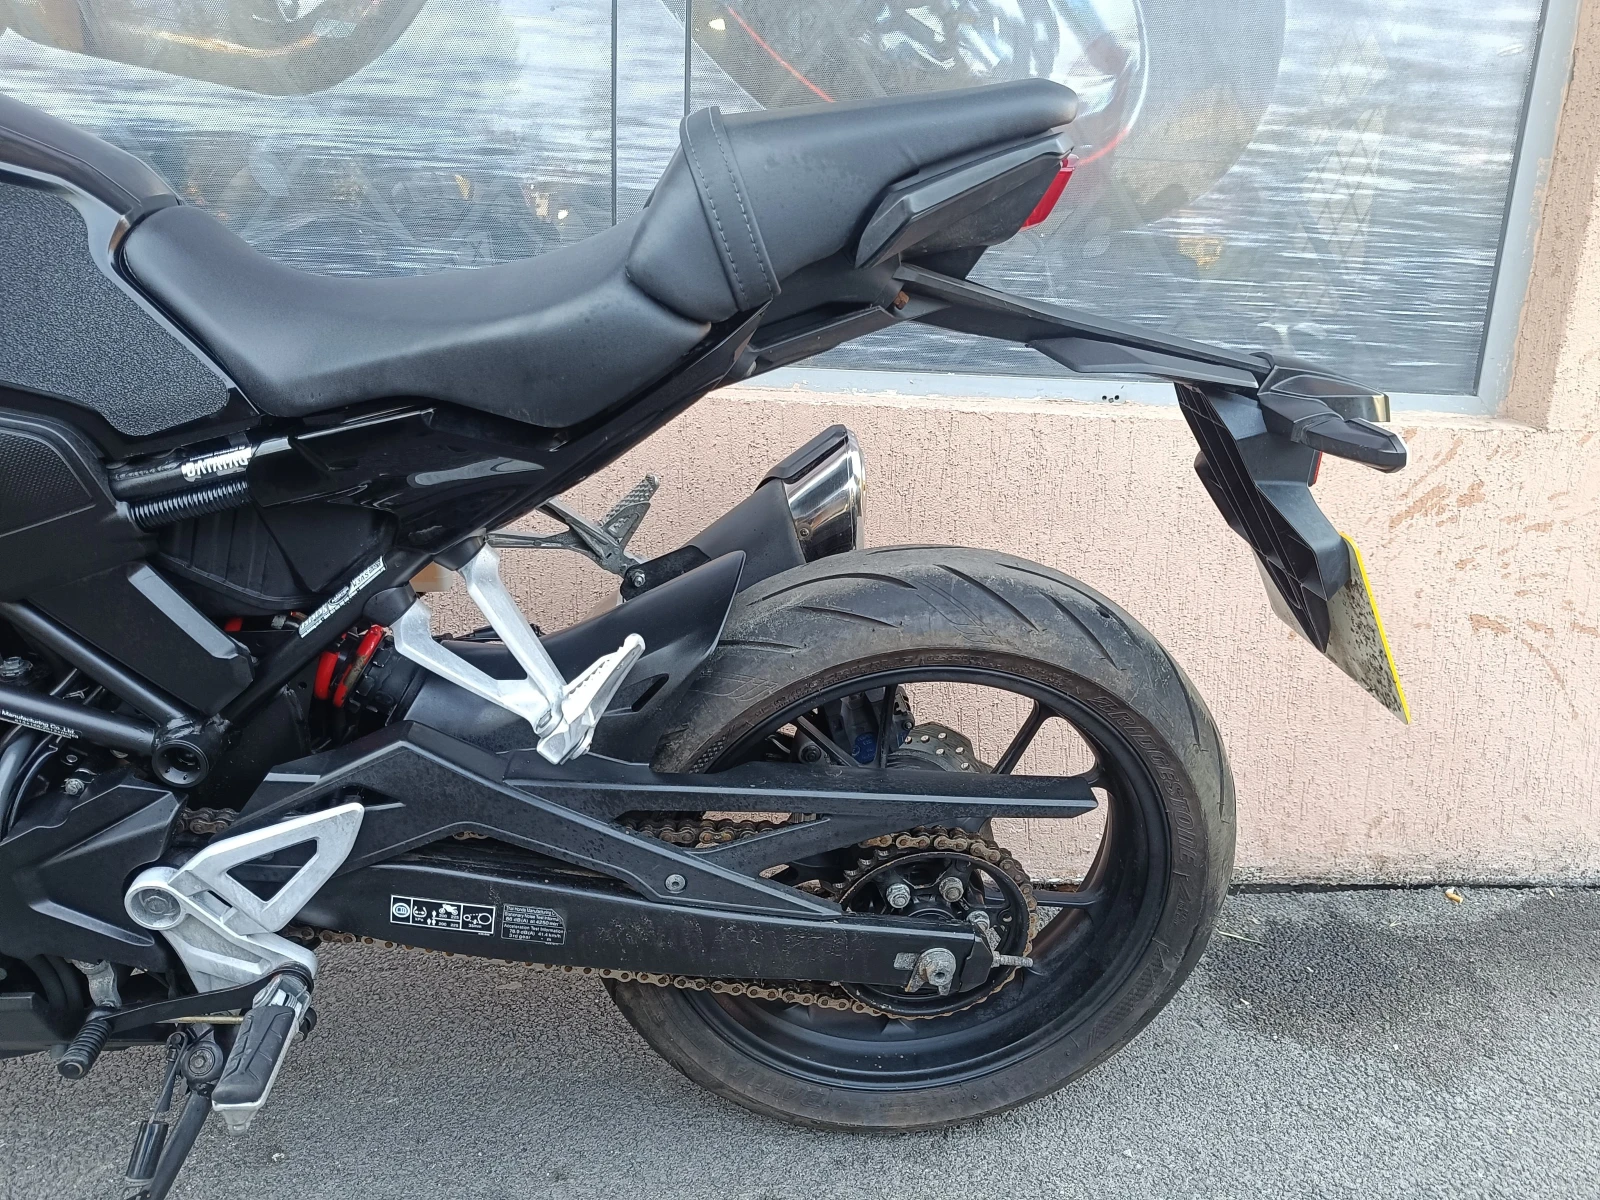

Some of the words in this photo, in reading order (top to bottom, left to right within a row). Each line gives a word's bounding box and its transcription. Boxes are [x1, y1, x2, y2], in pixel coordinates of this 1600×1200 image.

[1, 709, 49, 728] Manufacturing
[1088, 696, 1198, 867] BRIDGESTONE
[540, 926, 564, 934] Information
